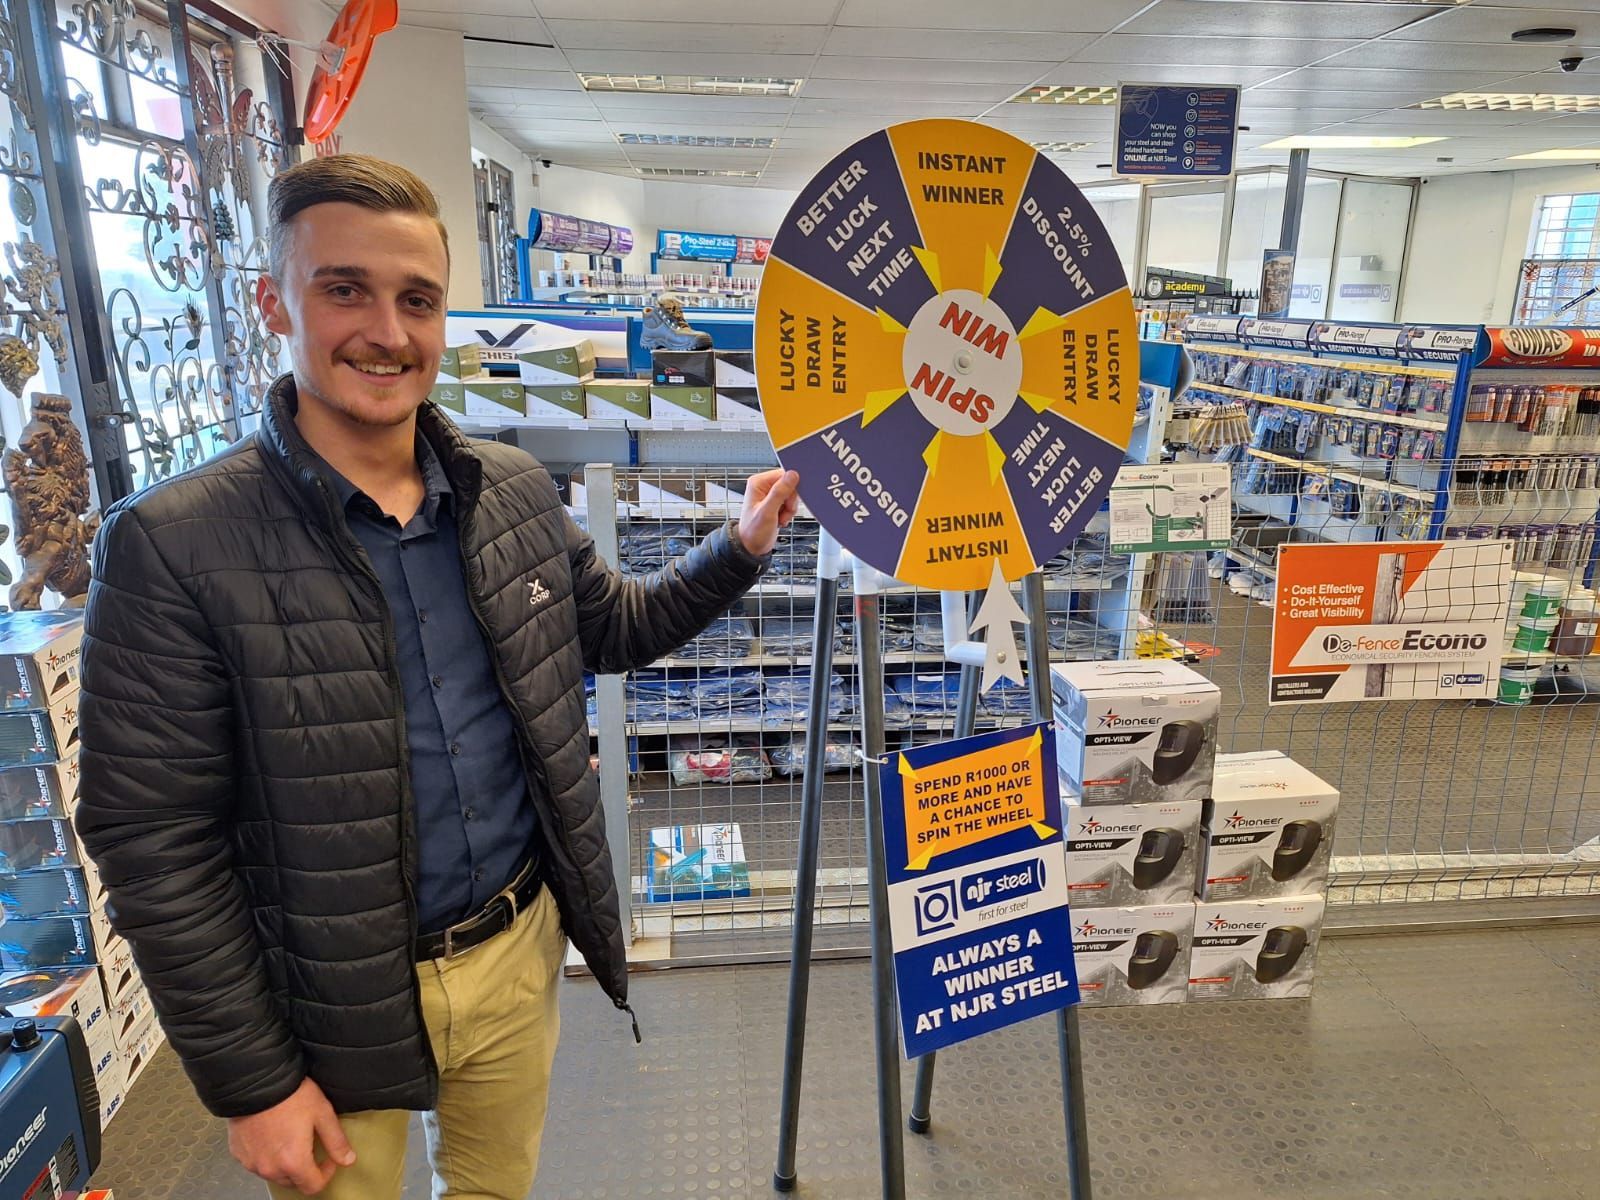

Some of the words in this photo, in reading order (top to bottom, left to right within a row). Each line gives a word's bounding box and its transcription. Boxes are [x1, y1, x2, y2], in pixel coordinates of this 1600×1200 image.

[918, 152, 1006, 174] INSTANT
[795, 159, 868, 237] BETTER
[922, 185, 1004, 205] WINNER
[826, 195, 878, 253] LUCK
[1057, 207, 1094, 257] 2.5%
[846, 220, 896, 277] NEXT
[1022, 197, 1096, 299] DISCOUNT
[867, 246, 913, 298] TIME
[1165, 282, 1205, 294] academy
[939, 302, 1010, 360] WIN
[1338, 330, 1364, 340] PRO-Range
[1436, 335, 1473, 346] PRO-Range
[779, 308, 795, 391] LUCKY
[807, 317, 821, 387] DRAW
[833, 315, 847, 394] ENTRY
[1063, 329, 1076, 405] ENTRY
[1086, 334, 1099, 401] DRAW
[1107, 329, 1121, 405] LUCKY
[1328, 344, 1356, 353] SECURITY
[1357, 346, 1377, 355] LOCKS
[1423, 352, 1460, 361] SECURITY
[911, 363, 995, 423] SPIN
[1012, 422, 1050, 466] TIME
[820, 428, 908, 528] DISCOUNT
[1030, 437, 1066, 488] NEXT
[827, 474, 871, 524] 2.5%
[1045, 457, 1082, 506] LUCK
[1049, 465, 1103, 534] BETTER
[926, 511, 1004, 533] WINNER
[926, 540, 1009, 563] INSTANT
[529, 589, 550, 605] CORP
[1291, 595, 1361, 607] Do-It-Yourself
[1292, 585, 1316, 595] Cost
[1319, 584, 1364, 594] Effective
[1290, 609, 1318, 618] Great
[1321, 607, 1364, 618] Visibility
[1332, 653, 1376, 661] ECONOMICAL
[1402, 630, 1487, 650] Econo
[1094, 736, 1132, 744] OPTI-VIEW
[914, 775, 961, 794] SPEND
[967, 765, 1007, 783] R1000
[1012, 760, 1030, 774] OR
[918, 791, 958, 810] MORE
[964, 784, 992, 800] AND
[997, 775, 1032, 792] HAVE
[917, 825, 950, 844] SPIN
[956, 819, 982, 835] THE
[988, 808, 1033, 827] WHEEL
[930, 812, 939, 825] A
[945, 799, 1001, 821] CHANCE
[1006, 793, 1023, 806] TO
[1219, 835, 1255, 843] OPTI-VIEW
[967, 876, 993, 903] njr
[996, 867, 1032, 892] steel
[979, 909, 995, 922] first
[996, 906, 1007, 916] for
[1008, 899, 1028, 914] steel
[932, 934, 1021, 976] ALWAYS
[1027, 928, 1042, 947] A
[944, 955, 1034, 997] WINNER
[86, 1006, 102, 1029] ABS
[915, 1007, 943, 1035] AT
[951, 993, 995, 1023] NJR
[1002, 970, 1069, 1005] STEEL
[97, 1051, 112, 1075] ABS
[106, 1094, 120, 1117] ABS
